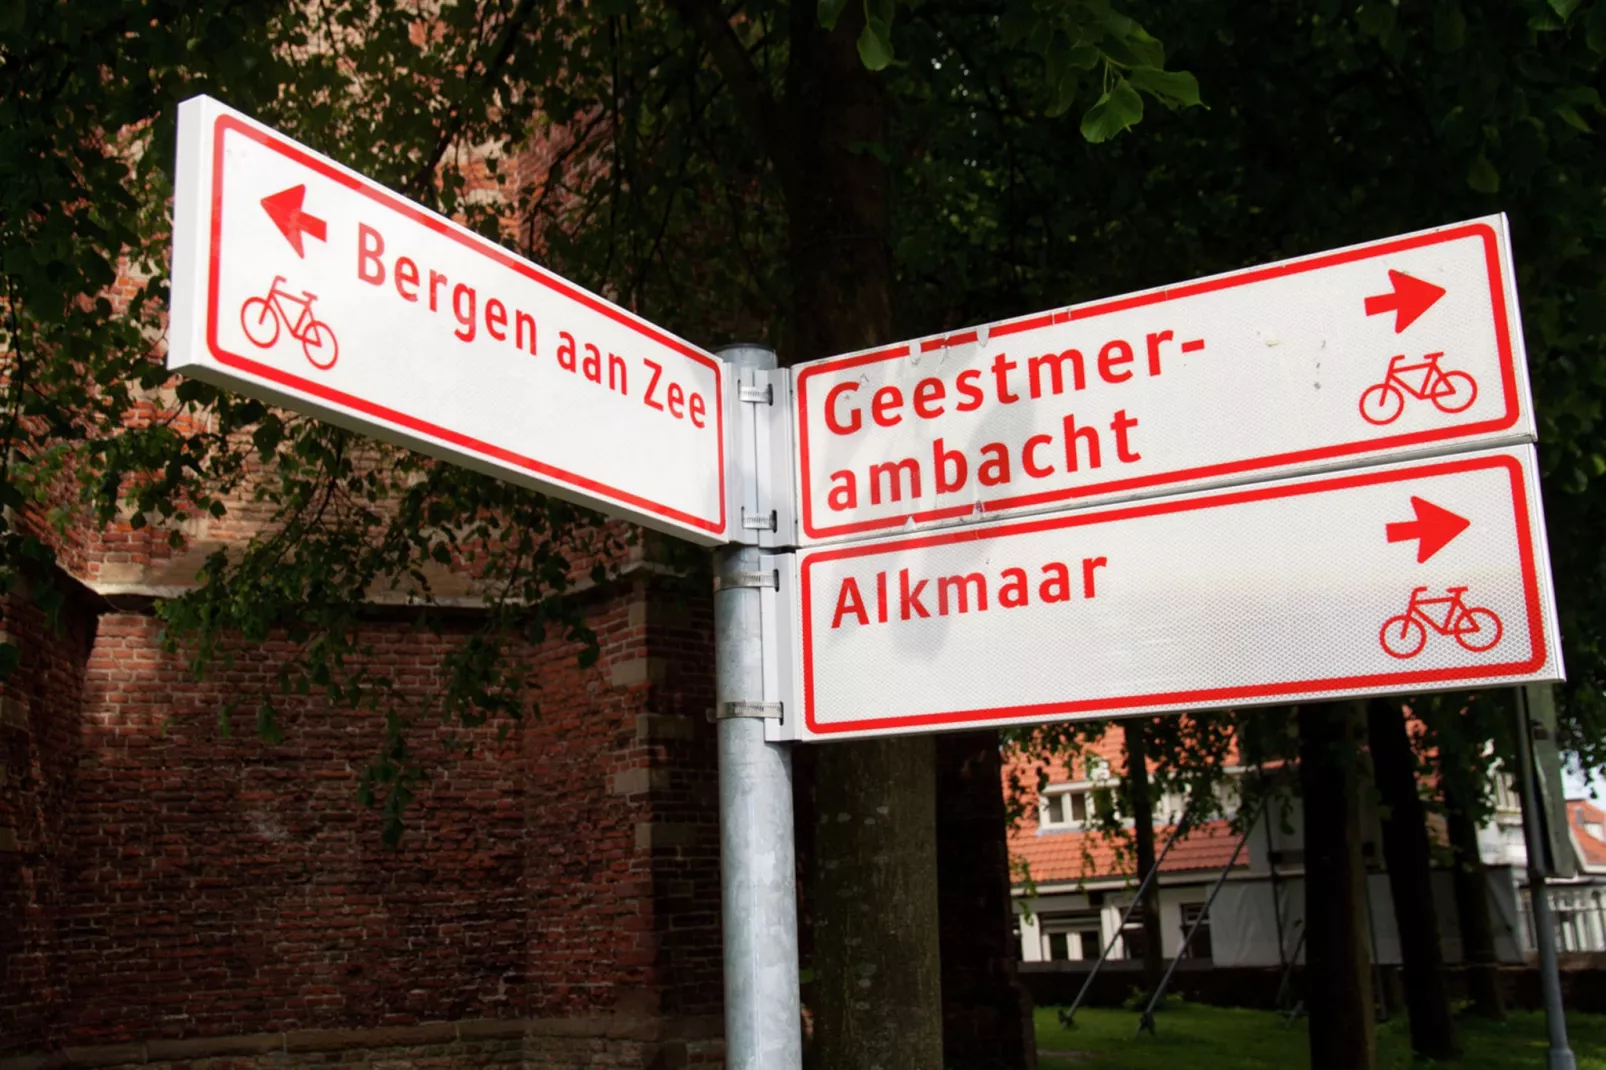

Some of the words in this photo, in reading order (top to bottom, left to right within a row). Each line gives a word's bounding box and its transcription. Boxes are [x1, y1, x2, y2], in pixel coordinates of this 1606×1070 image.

[357, 222, 538, 357] Bergen
[555, 330, 628, 397] aan
[642, 357, 706, 429] Zee
[823, 328, 1206, 437] Geestmer-
[827, 408, 1142, 513] ambacht
[831, 555, 1108, 630] Alkmaar
